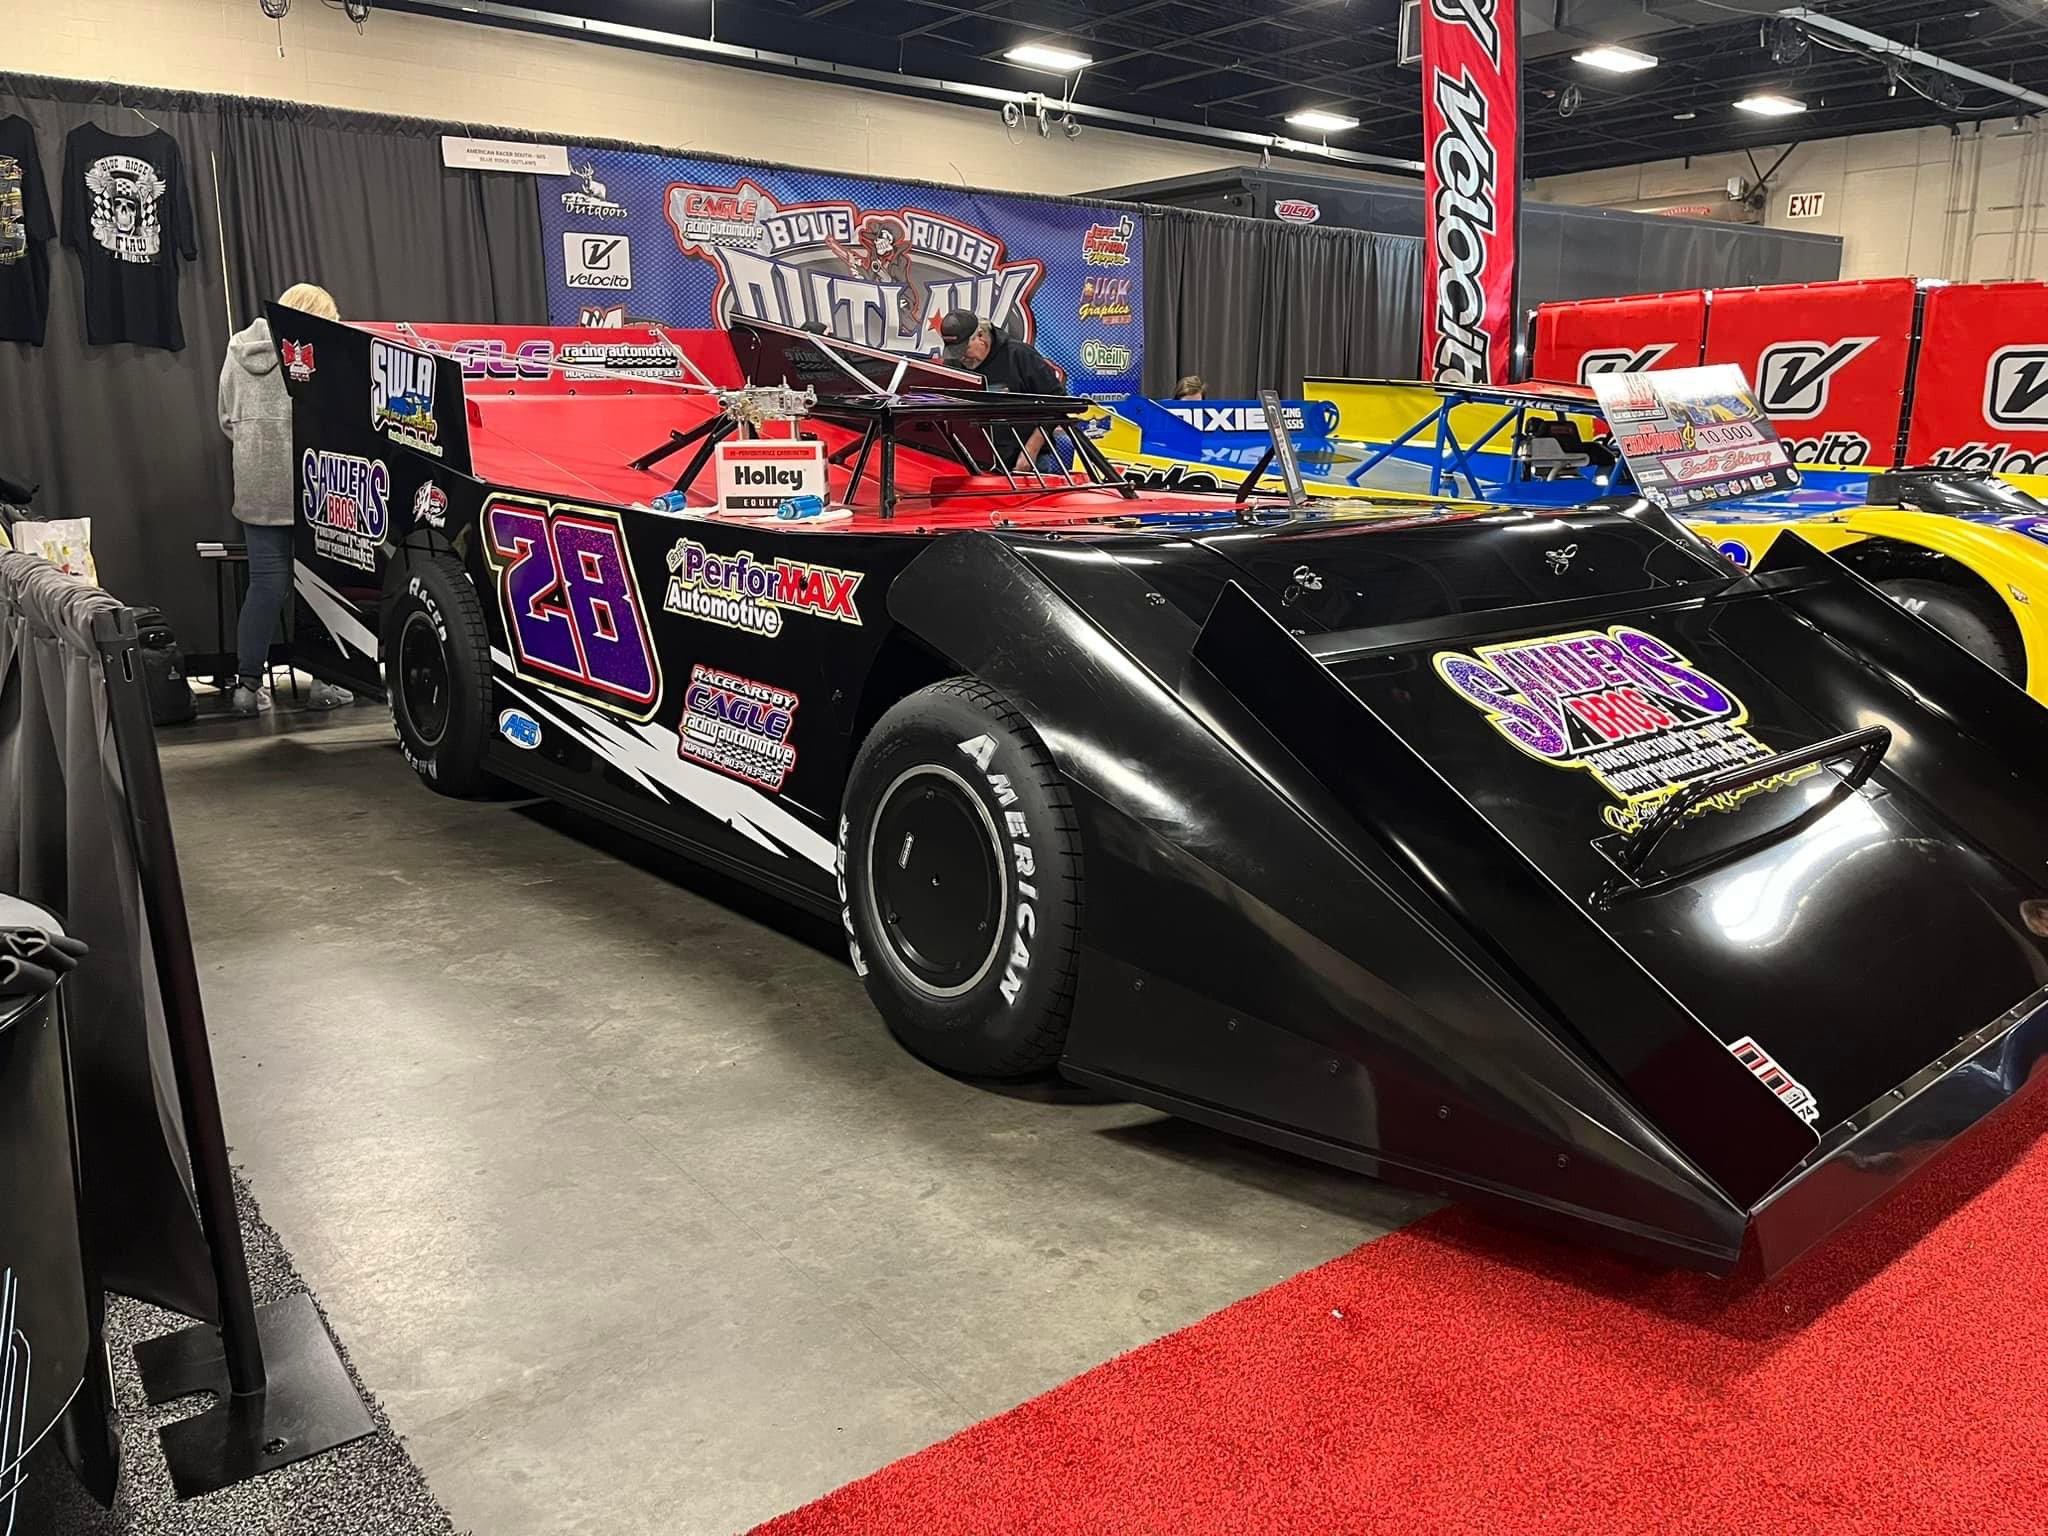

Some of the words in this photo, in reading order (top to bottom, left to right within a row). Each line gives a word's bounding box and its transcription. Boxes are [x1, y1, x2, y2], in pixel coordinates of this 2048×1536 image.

[566, 201, 628, 221] Outdoors
[685, 194, 757, 221] CAGLE
[1789, 194, 1822, 217] EXIT
[768, 212, 850, 252] BLUE
[912, 220, 993, 270] RIDGE
[1079, 303, 1130, 321] Graphics
[565, 344, 606, 358] racing
[608, 346, 677, 358] automotiv
[1084, 342, 1130, 369] O'Reilly
[370, 340, 434, 424] SWLA
[1622, 430, 1682, 457] CHAMPION
[1700, 424, 1753, 445] 10,000
[303, 453, 387, 536] SANDERS
[735, 465, 803, 491] Holley
[743, 498, 785, 507] EQUIP
[684, 546, 857, 619] PerforMAX
[485, 500, 657, 706] 28
[667, 580, 779, 633] Automotive
[694, 669, 770, 701] RACECARS
[771, 692, 797, 708] BY
[1440, 629, 1735, 757] SANDERS
[686, 684, 790, 741] CAGLE
[719, 727, 794, 763] automotive
[1585, 731, 1686, 772] CONSTRUCTION
[1605, 766, 1658, 792] NORTH
[958, 732, 1038, 1006] AMERICAN
